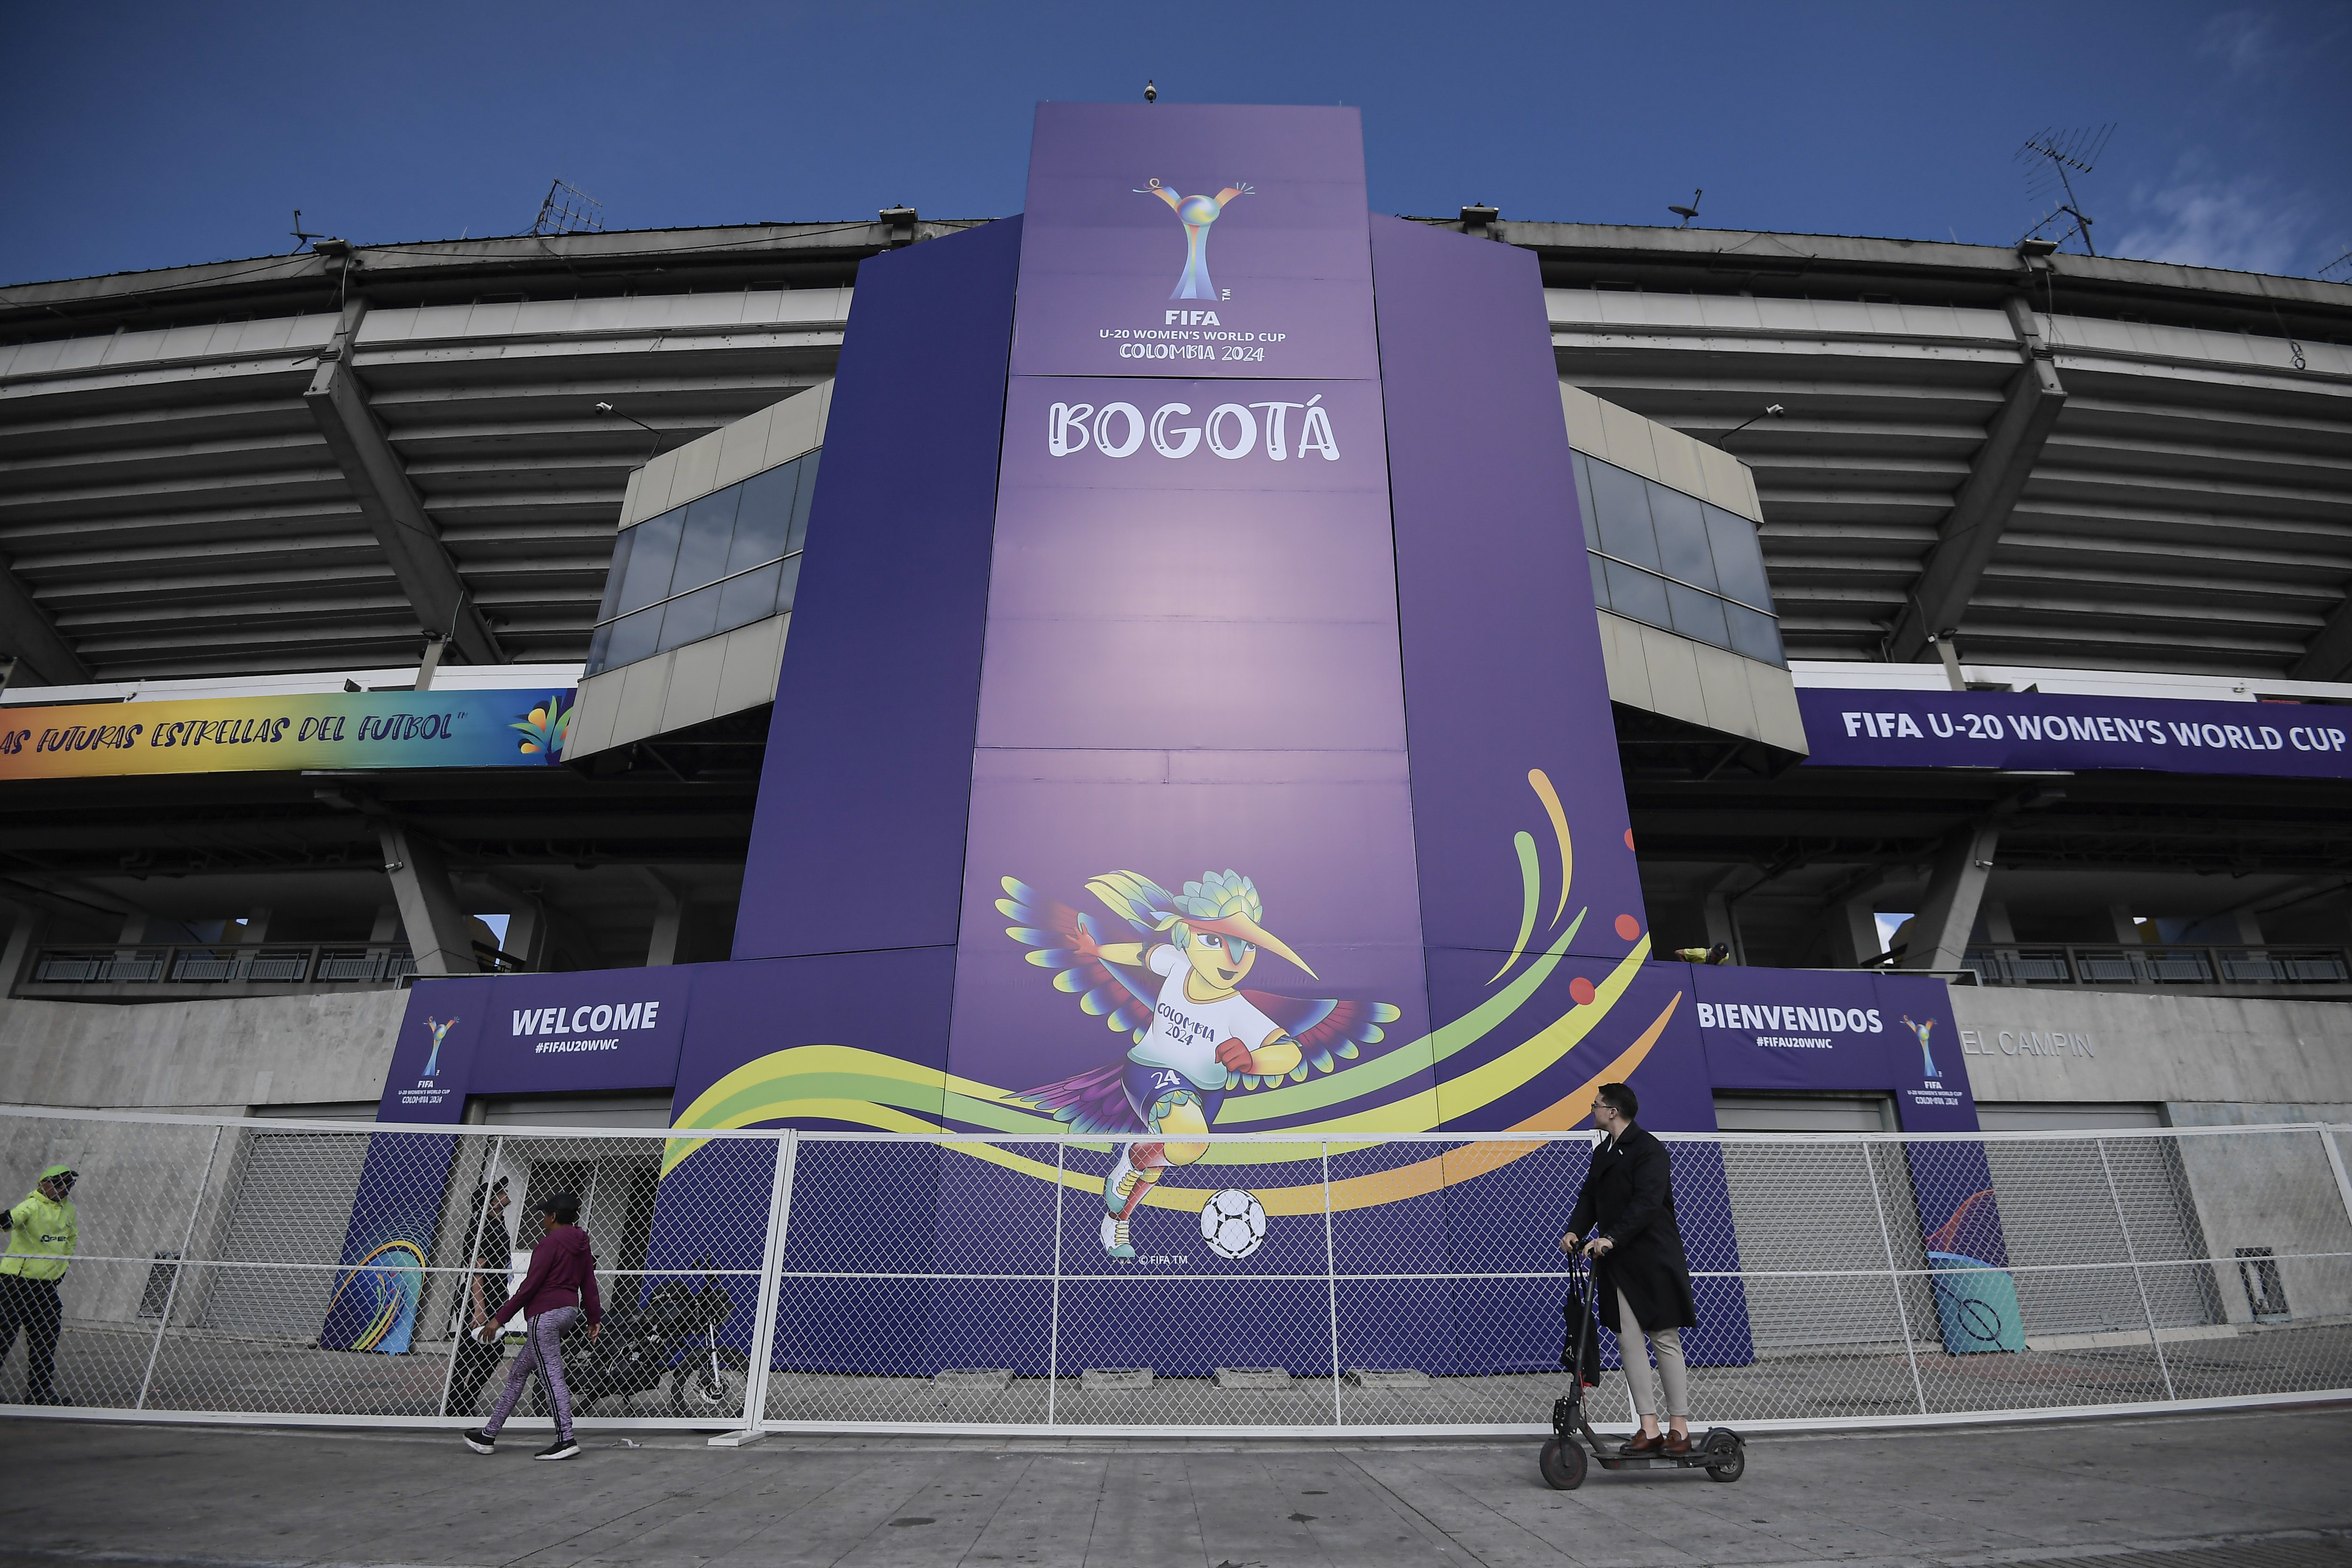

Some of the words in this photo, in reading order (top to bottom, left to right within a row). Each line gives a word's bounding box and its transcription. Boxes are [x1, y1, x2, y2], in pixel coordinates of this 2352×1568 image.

[1165, 310, 1220, 326] FIFA
[1099, 329, 1129, 338] U-20
[1133, 330, 1200, 340] WOMEN'S
[1203, 331, 1255, 341] WORLD
[1258, 333, 1286, 342] CUP
[1120, 343, 1216, 360] COLOMBIA
[1222, 346, 1265, 361] 2024
[1049, 394, 1340, 461] BOGOTÁ
[37, 724, 143, 753] FUTURAS
[151, 717, 291, 748] ESTRELLAS
[298, 716, 346, 742] DEL
[358, 713, 452, 741] FUTBOL
[1841, 712, 1924, 738] FIFA
[1927, 713, 2004, 740] U-20
[2007, 715, 2167, 744] WOMEN'S
[2167, 722, 2283, 749] WORLD
[2289, 727, 2346, 751] CUP
[512, 1001, 660, 1036] WELCOME
[1157, 1003, 1215, 1042] COLOMBIA
[1697, 1003, 1883, 1033] BIENVENIDOS
[1165, 1022, 1193, 1045] 2024
[1756, 1036, 1833, 1049] #FIFAU20WWC
[1960, 1031, 1994, 1055] EL
[1999, 1031, 2094, 1058] CAMPIN
[535, 1038, 619, 1054] #FIFAU20WWC
[1151, 1069, 1180, 1089] 24
[1151, 1256, 1170, 1265] FIFA
[1172, 1255, 1188, 1264] TM
